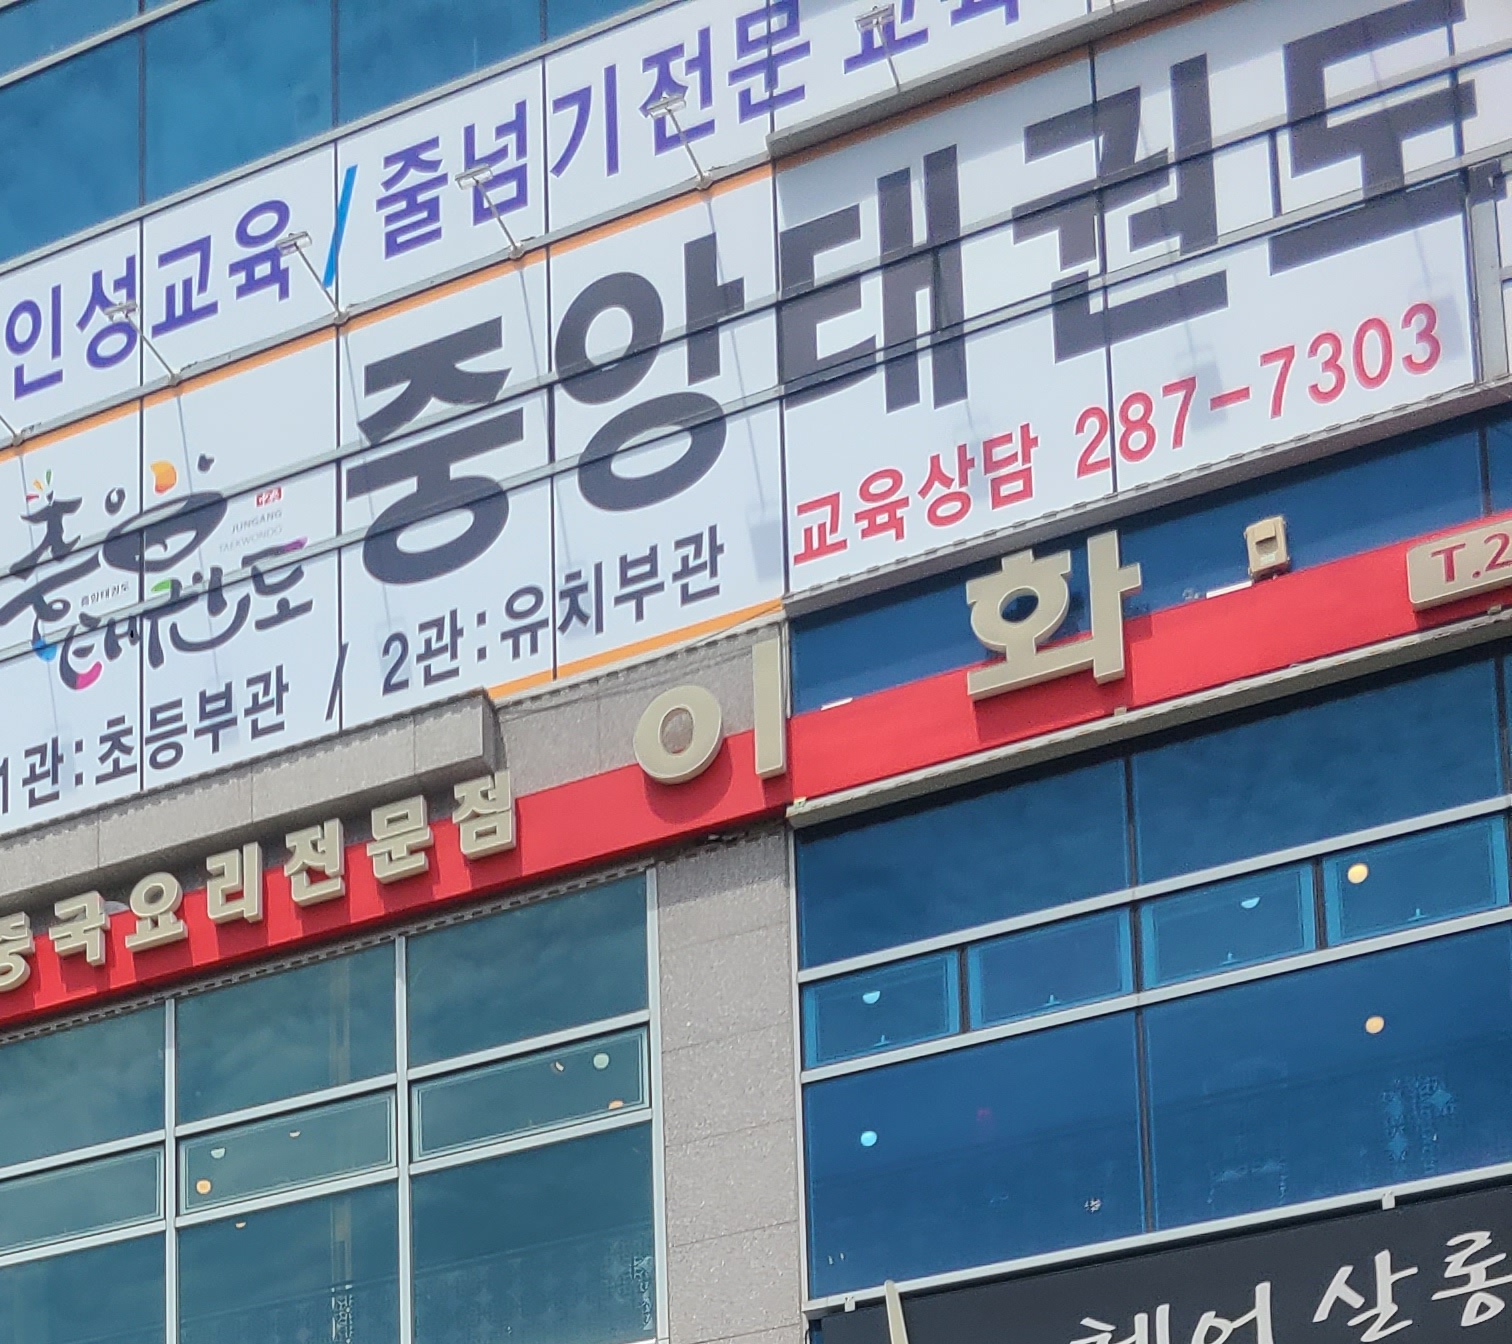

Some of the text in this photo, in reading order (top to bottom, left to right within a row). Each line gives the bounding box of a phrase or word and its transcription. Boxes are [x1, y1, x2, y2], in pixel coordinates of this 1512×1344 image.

[5, 199, 292, 398] 인성교육
[345, 0, 1478, 588] 중앙태권도
[232, 510, 283, 534] JUNGANG
[792, 302, 1442, 566] 교육상담 287-7303
[1312, 1230, 1512, 1342] 살롱
